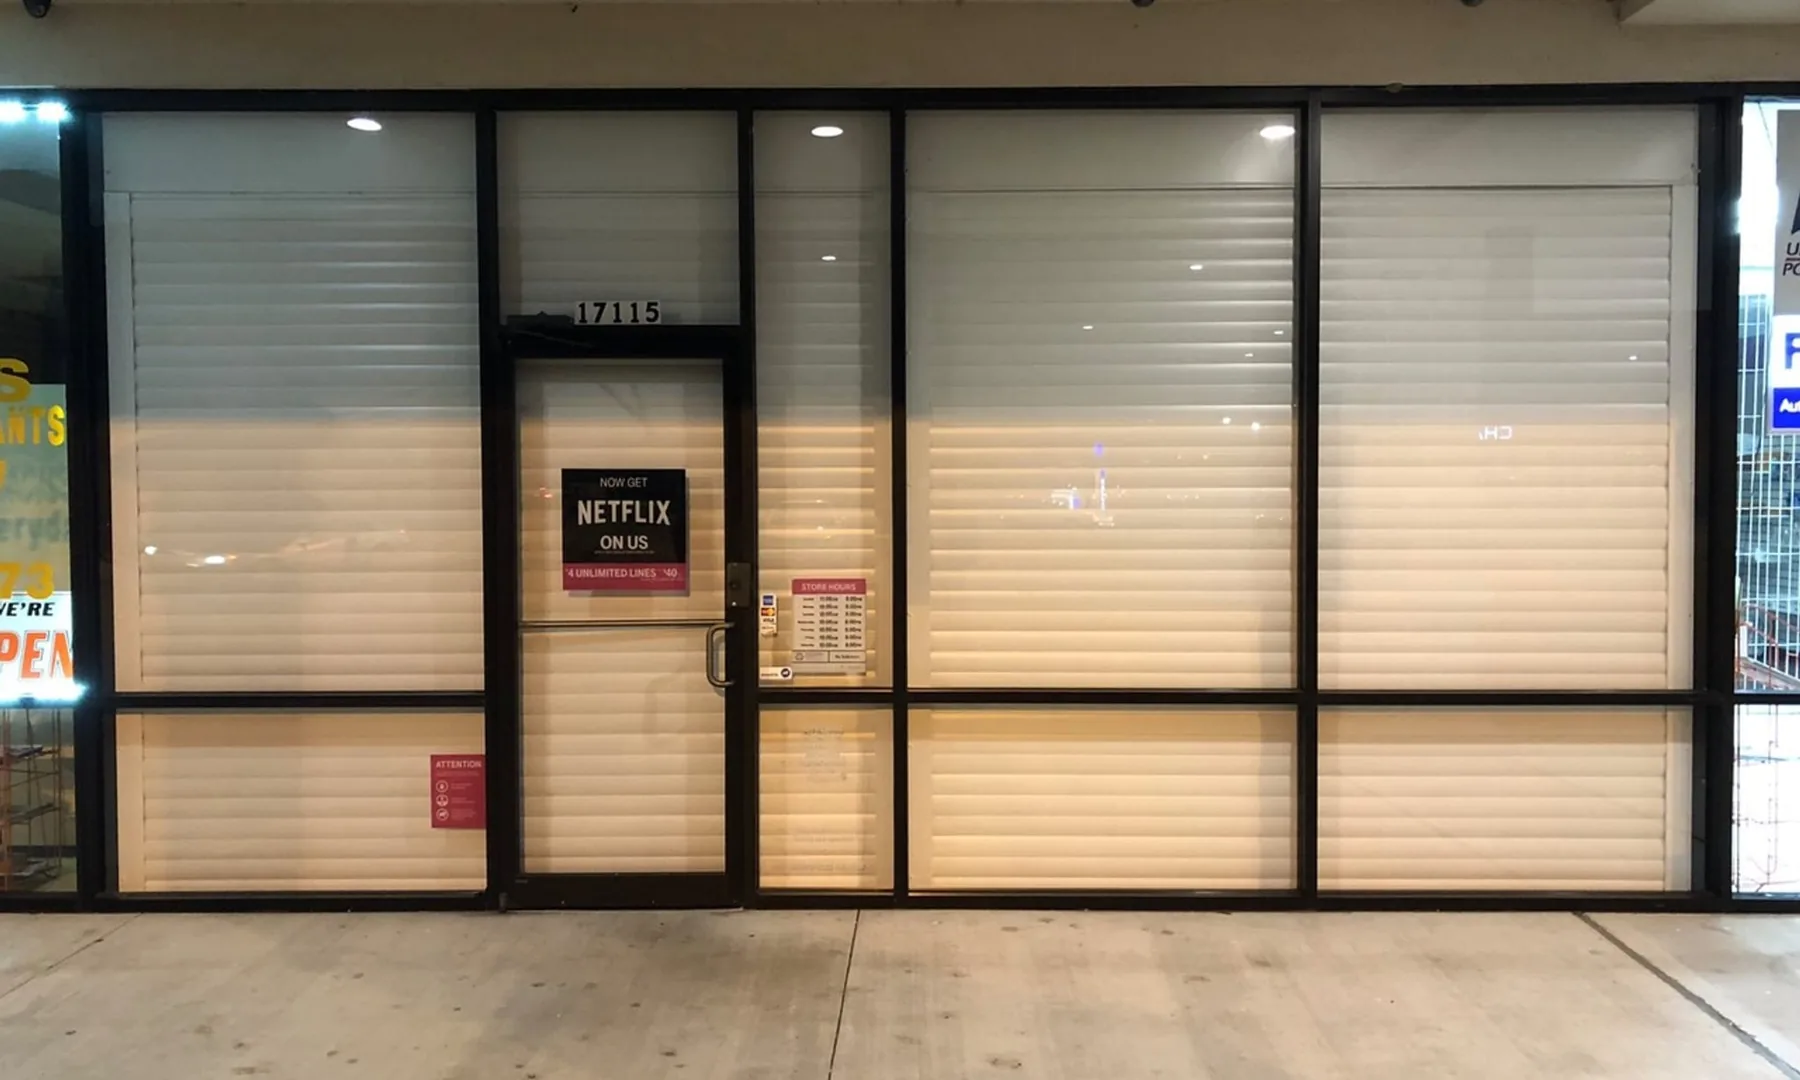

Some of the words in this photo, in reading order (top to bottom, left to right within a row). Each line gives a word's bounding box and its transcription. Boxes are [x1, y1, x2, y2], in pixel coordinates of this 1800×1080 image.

[577, 301, 660, 323] 17115
[600, 477, 625, 488] NOW
[627, 477, 648, 488] GET
[577, 499, 671, 526] NETFLIX
[600, 535, 624, 550] ON
[627, 535, 649, 550] US
[575, 567, 628, 578] UNLIMITED
[629, 567, 657, 578] LINES
[801, 583, 827, 591] STORE
[828, 583, 857, 591] HOURS
[435, 760, 482, 768] ATTENTION
